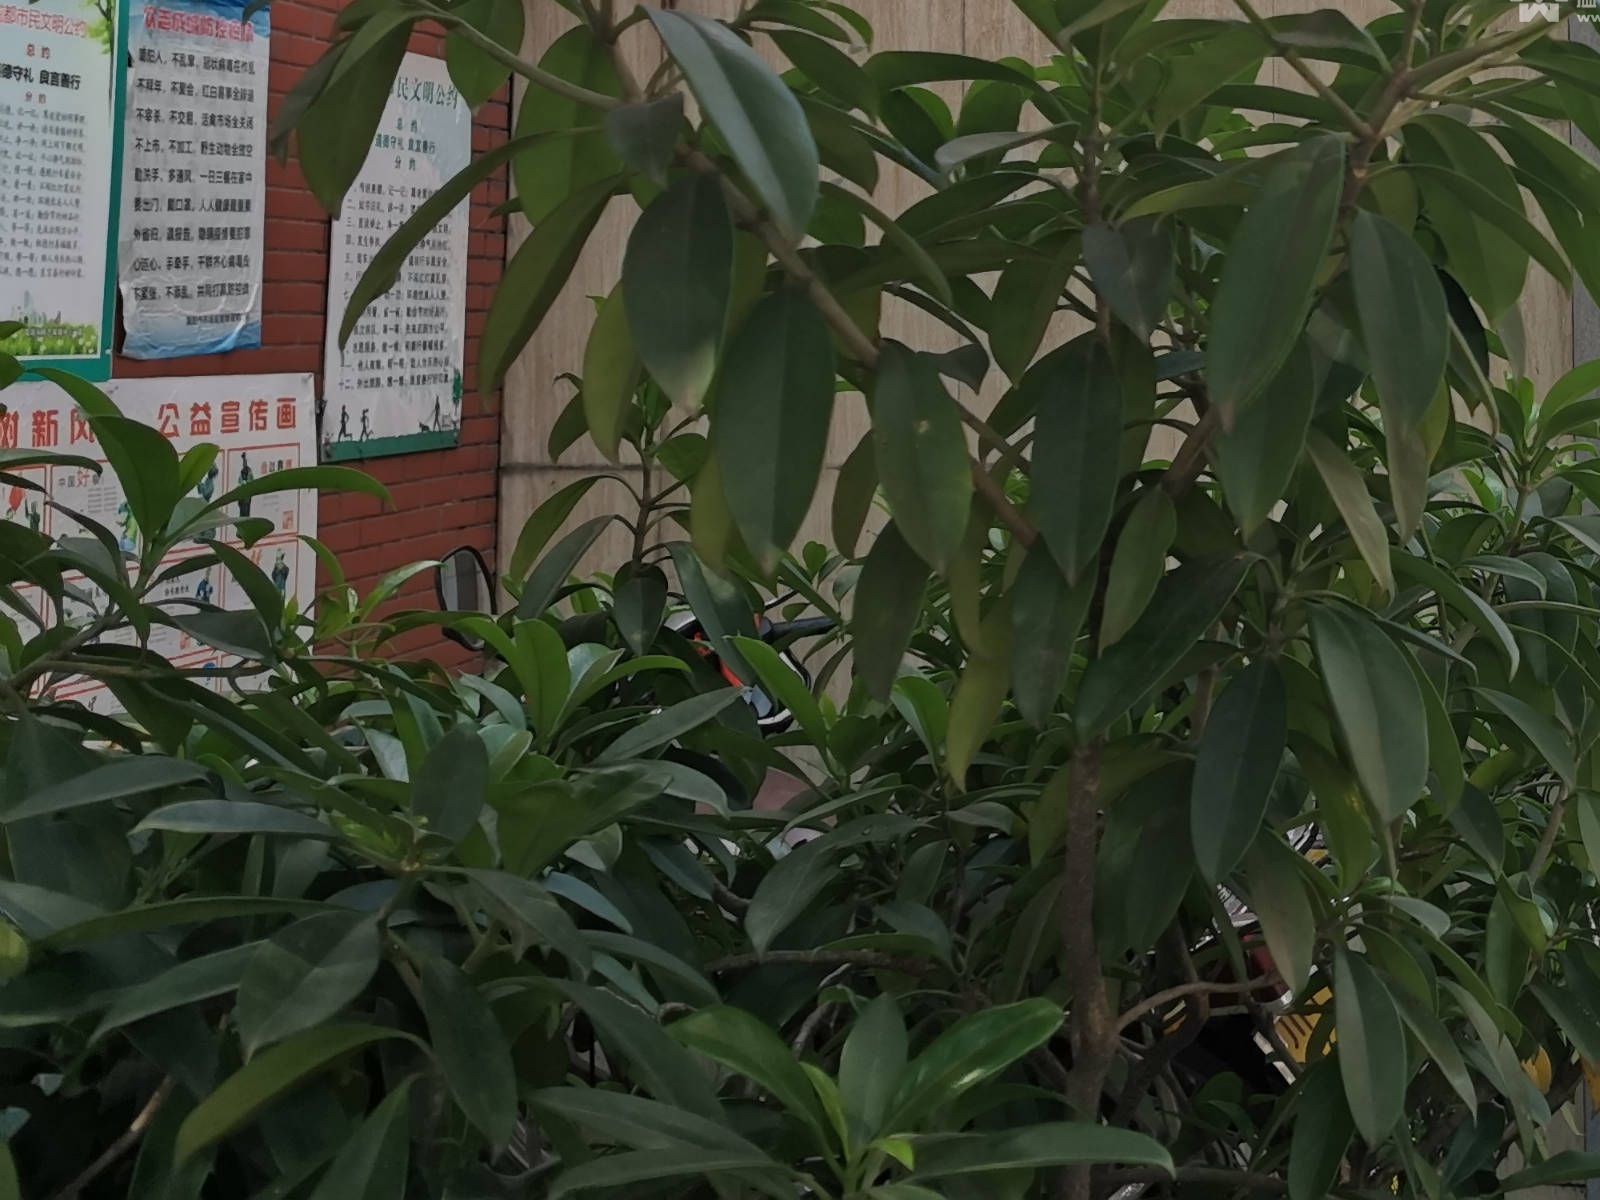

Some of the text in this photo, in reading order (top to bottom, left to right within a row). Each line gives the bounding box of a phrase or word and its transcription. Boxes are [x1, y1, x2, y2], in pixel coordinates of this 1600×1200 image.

[391, 76, 458, 109] 民文明公约
[157, 397, 297, 439] 公益宣传画
